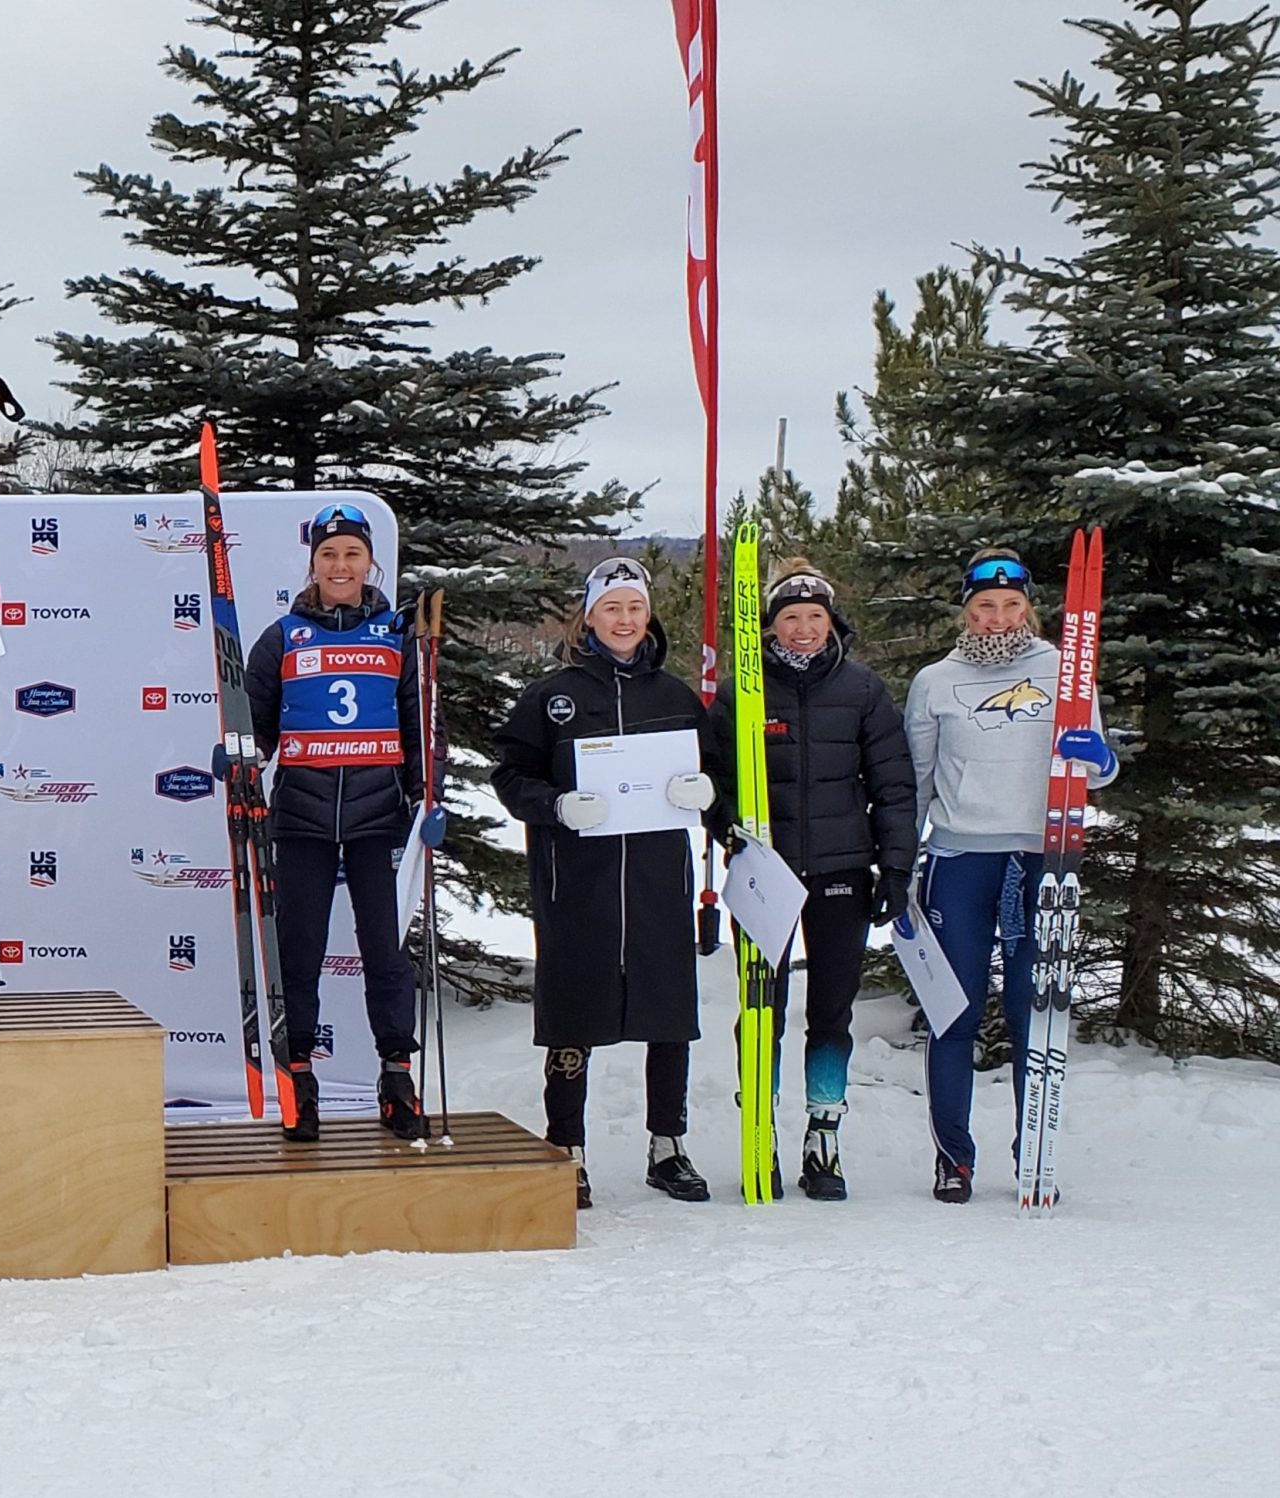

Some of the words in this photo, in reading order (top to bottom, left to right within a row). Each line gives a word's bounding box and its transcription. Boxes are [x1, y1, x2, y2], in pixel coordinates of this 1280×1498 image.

[31, 518, 58, 531] US
[174, 594, 201, 607] US
[31, 608, 91, 619] TOYOTA
[740, 580, 751, 695] FISCHER
[325, 653, 387, 666] TOYOTA
[1060, 612, 1079, 702] MADSHUS
[1078, 610, 1096, 700] MADSHUS
[172, 693, 218, 704] TOYOT
[327, 679, 359, 725] 3
[307, 740, 377, 755] MICHIGAN
[30, 851, 57, 864] US
[169, 935, 196, 948] US
[28, 946, 87, 958] TOYOTA
[169, 1032, 226, 1043] TOYOTA
[1026, 1049, 1045, 1082] 3.0
[1047, 1048, 1067, 1082] 3.0
[1027, 1081, 1040, 1131] REDLINE
[1048, 1081, 1060, 1131] REDLINE
